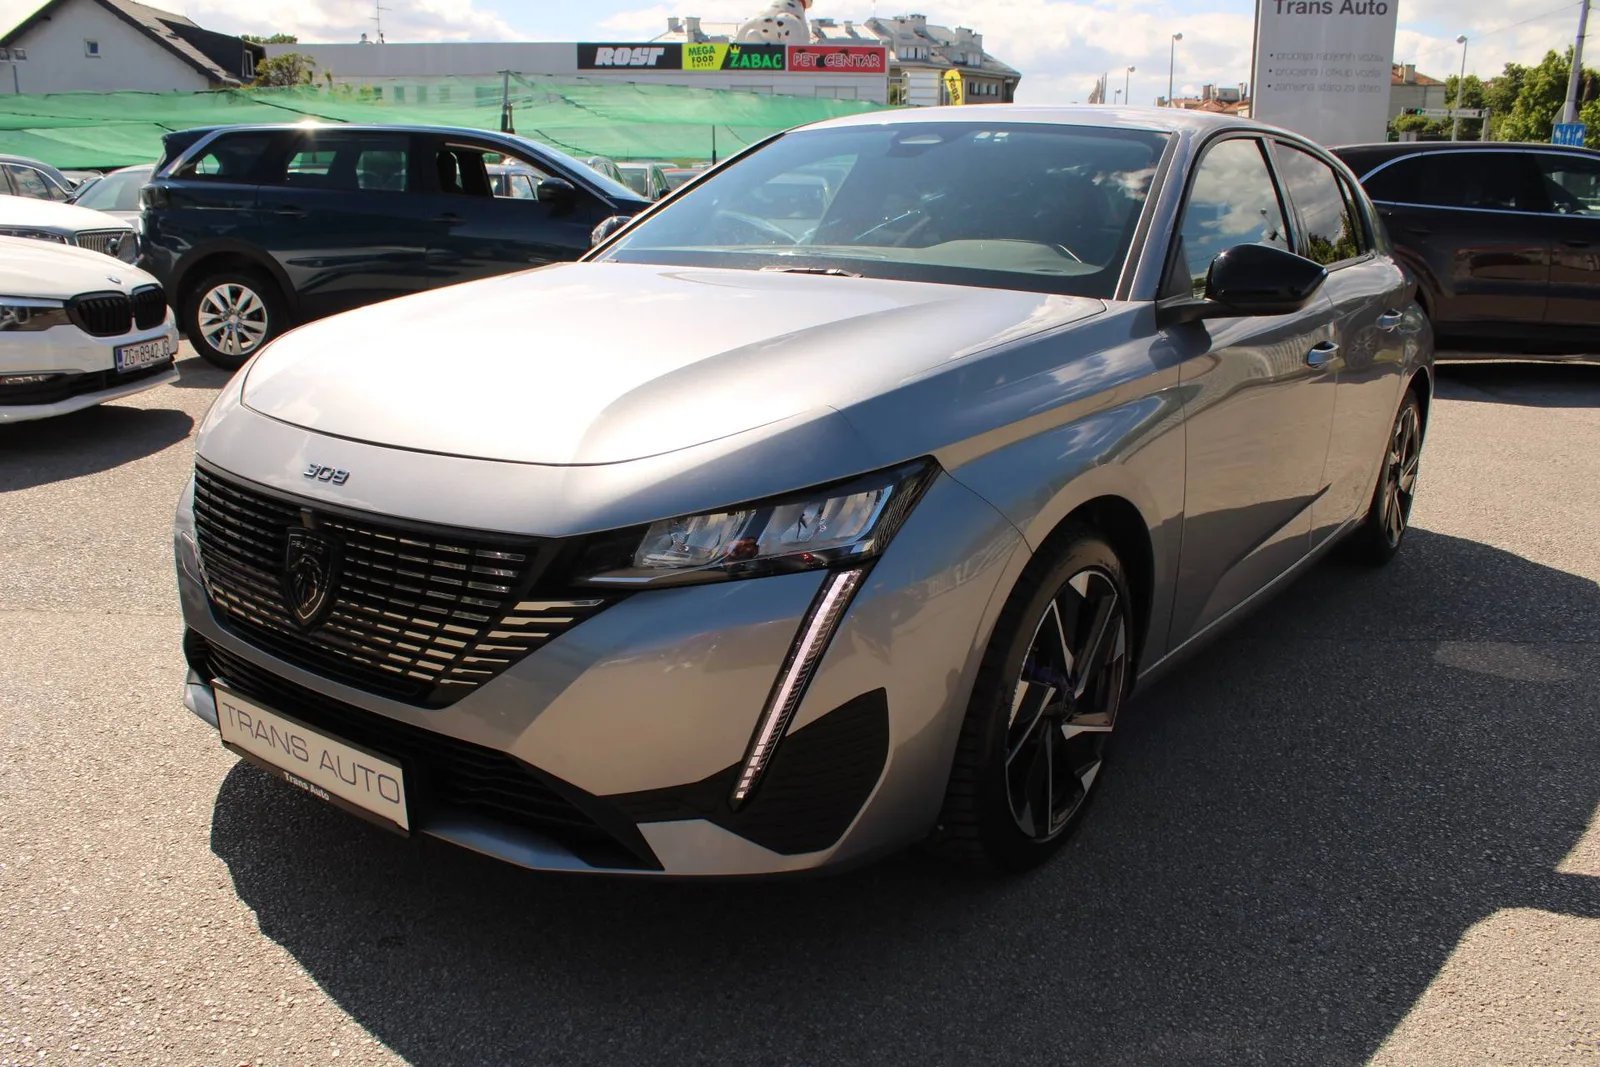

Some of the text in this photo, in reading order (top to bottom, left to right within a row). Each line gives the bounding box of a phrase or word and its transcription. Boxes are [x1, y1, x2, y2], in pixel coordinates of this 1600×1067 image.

[1273, 0, 1388, 15] Trans Auto
[594, 47, 665, 66] ROST
[688, 45, 716, 56] MEGA
[691, 55, 714, 63] FOOD
[793, 53, 880, 67] PET CENTAR
[123, 348, 135, 366] ZG
[303, 463, 350, 486] 308
[222, 702, 400, 804] TRANS AUTO
[283, 771, 330, 801] Trans Auto
